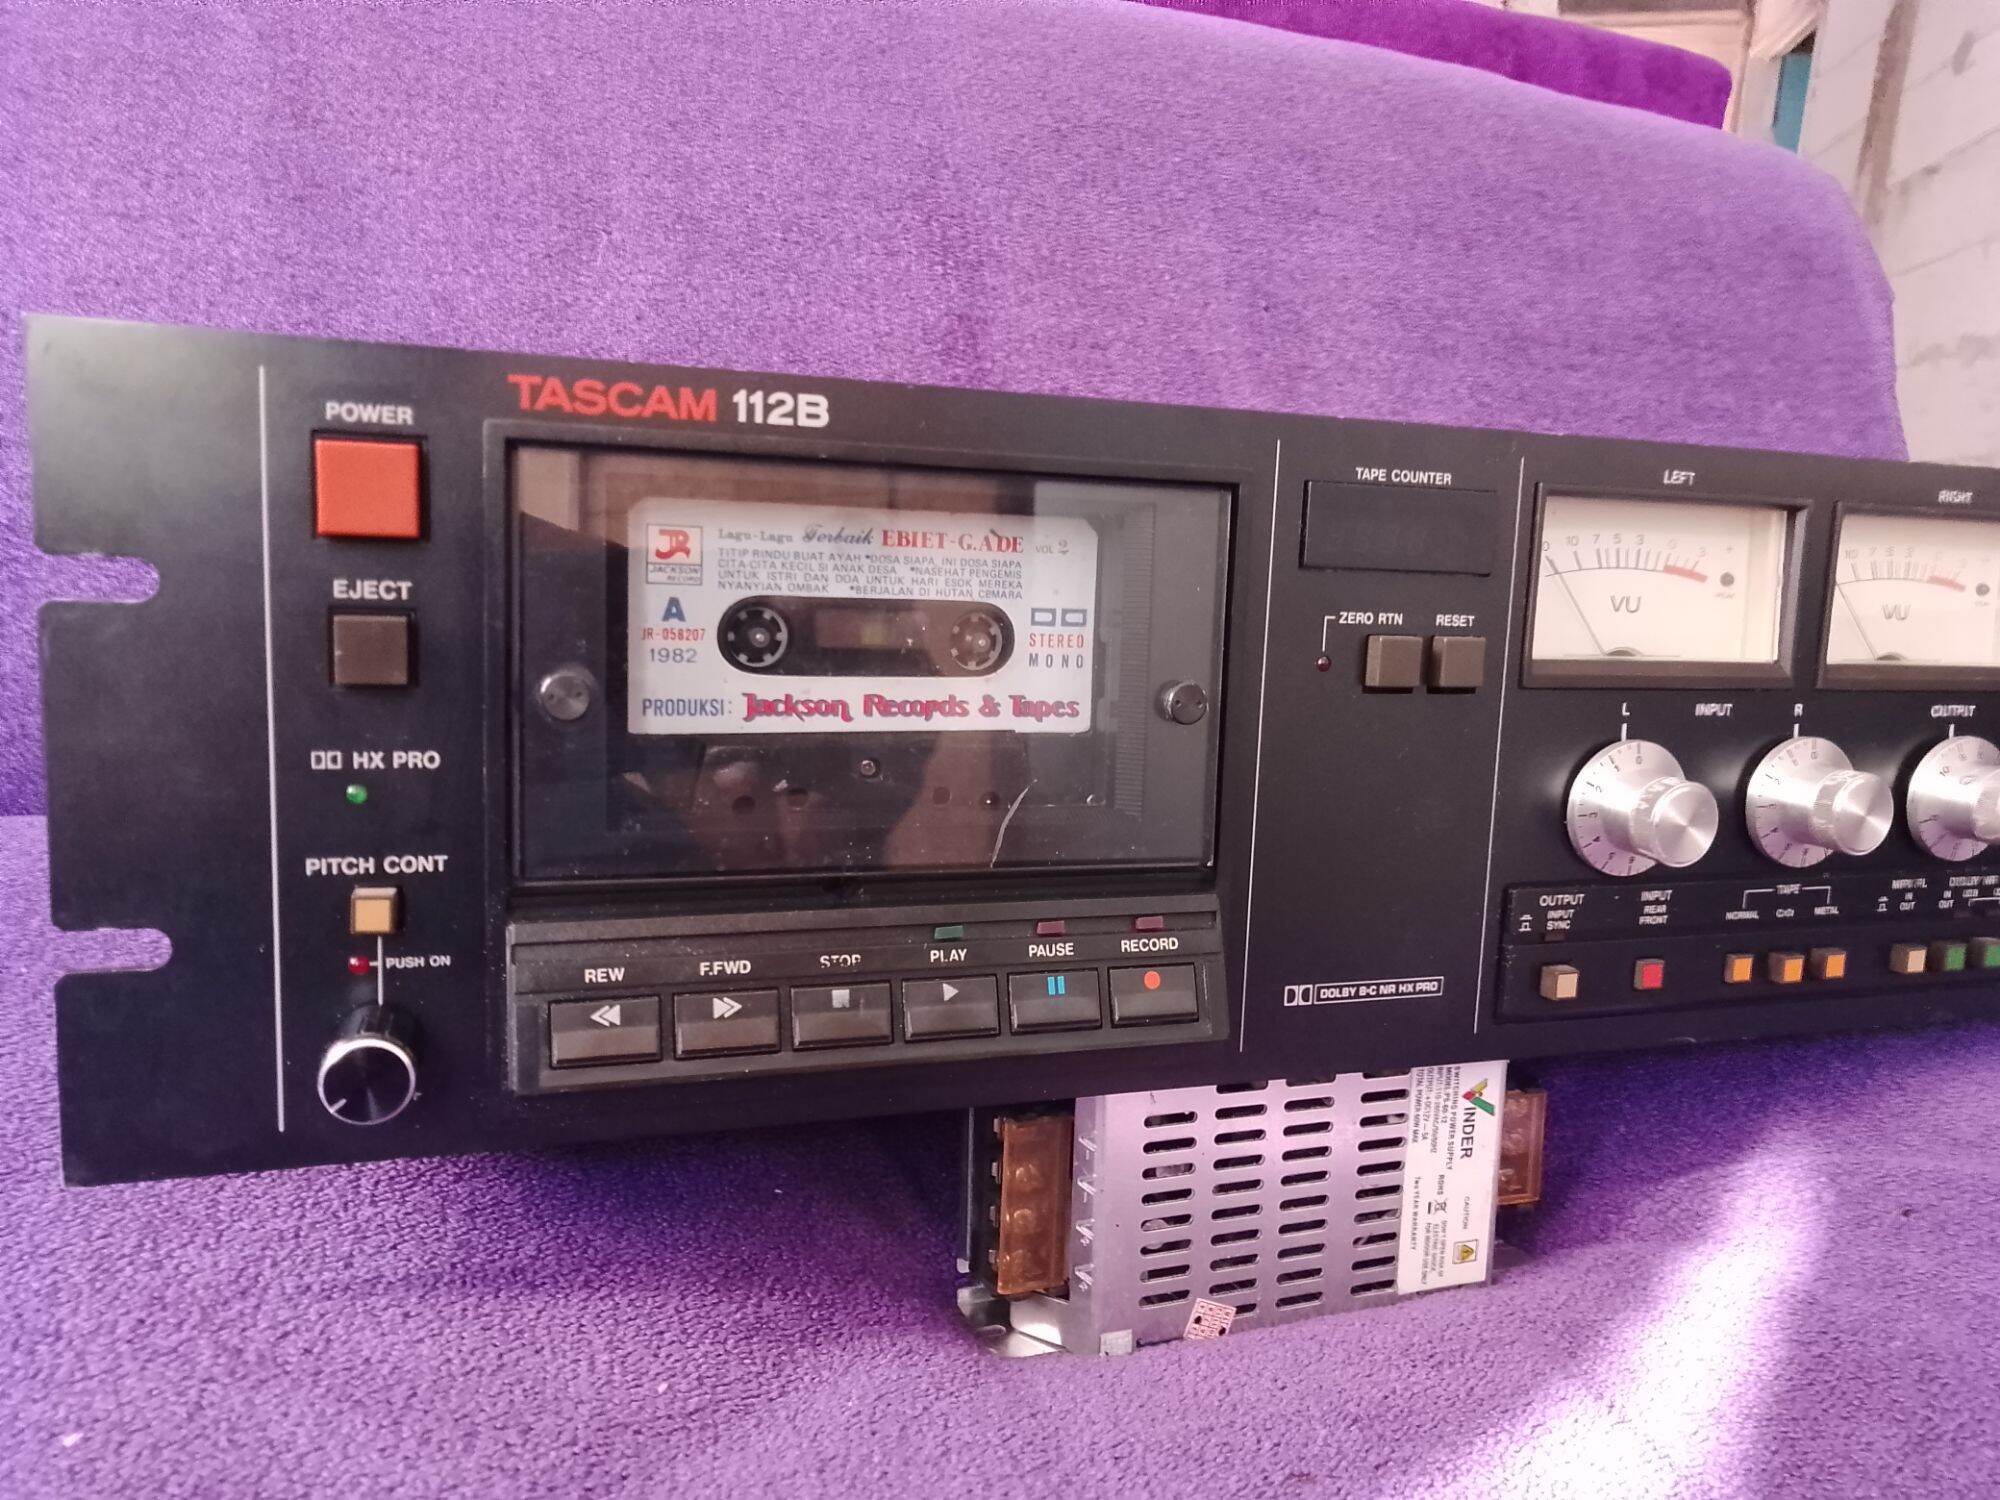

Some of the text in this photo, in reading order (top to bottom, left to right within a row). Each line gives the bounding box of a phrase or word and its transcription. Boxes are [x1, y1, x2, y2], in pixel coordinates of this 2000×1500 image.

[507, 373, 830, 428] TASCAM 112B
[325, 401, 415, 425] POWER
[1355, 466, 1453, 486] TAPE COUNTER
[1663, 469, 1696, 486] LEFT
[1938, 488, 1974, 504] RIGHT
[717, 528, 793, 544] Lagu-Lagu
[802, 523, 874, 545] Terbaik
[1566, 535, 1580, 547] 10
[1593, 534, 1601, 544] 7
[1612, 534, 1621, 544] 5
[1637, 534, 1645, 545] 3
[717, 548, 749, 558] TITIP
[752, 550, 791, 561] RINDU
[793, 551, 825, 562] BUAT
[828, 552, 862, 563] AYAH
[941, 558, 957, 568] INI
[960, 559, 988, 569] DOSA
[991, 560, 1022, 570] SIAPA
[1035, 546, 1054, 555] VOL
[781, 562, 815, 572] KECIL
[818, 563, 829, 573] SI
[832, 564, 865, 574] ANAK
[868, 565, 898, 575] DESA
[969, 569, 1023, 580] PENGEMIS
[717, 570, 1023, 590] UNTUK ISTRI DAN DOA UNTUK HARI ESOK MEREKA
[332, 578, 414, 601] EJECT
[717, 581, 783, 593] NYANYIAN
[787, 583, 830, 594] OMBAK
[919, 587, 930, 597] DI
[935, 588, 974, 599] HUTAN
[978, 589, 1024, 600] CEMARA
[661, 596, 687, 622] A
[1610, 594, 1642, 614] VU
[1882, 602, 1911, 621] VU
[1338, 611, 1404, 625] ZERO RTN
[1435, 614, 1476, 627] RESET
[1028, 633, 1085, 648] STEREO
[649, 647, 698, 664] 1982
[641, 692, 1080, 723] PRODUKSI: Jackson Records & Tapes
[1621, 702, 1631, 717] L
[1694, 702, 1734, 717] INPUT
[1793, 702, 1804, 717] R
[1930, 704, 1977, 718] OUTPUT
[352, 750, 442, 770] HX PRO
[305, 855, 449, 876] PITCH CONT
[1539, 893, 1586, 907] OUTPUT
[1640, 889, 1673, 901] INPUT
[1547, 909, 1575, 919] INPUT
[1643, 904, 1667, 914] REAR
[1899, 902, 1916, 911] OUT
[1546, 920, 1572, 931] SYNC
[1028, 942, 1075, 958] PAUSE
[1120, 937, 1180, 953] RECORD
[386, 955, 452, 969] PUSH ON
[819, 954, 863, 969] STOP
[929, 948, 968, 964] PLAY
[584, 966, 626, 984] REW
[699, 960, 752, 977] F.FWD
[1320, 987, 1357, 999] DOLBY
[1379, 984, 1396, 995] NR
[1398, 983, 1415, 993] HX
[1415, 981, 1439, 992] PRO
[1446, 1066, 1461, 1171] SWITCHING POWER SUPPLY
[1410, 1211, 1420, 1251] WARRANTY
